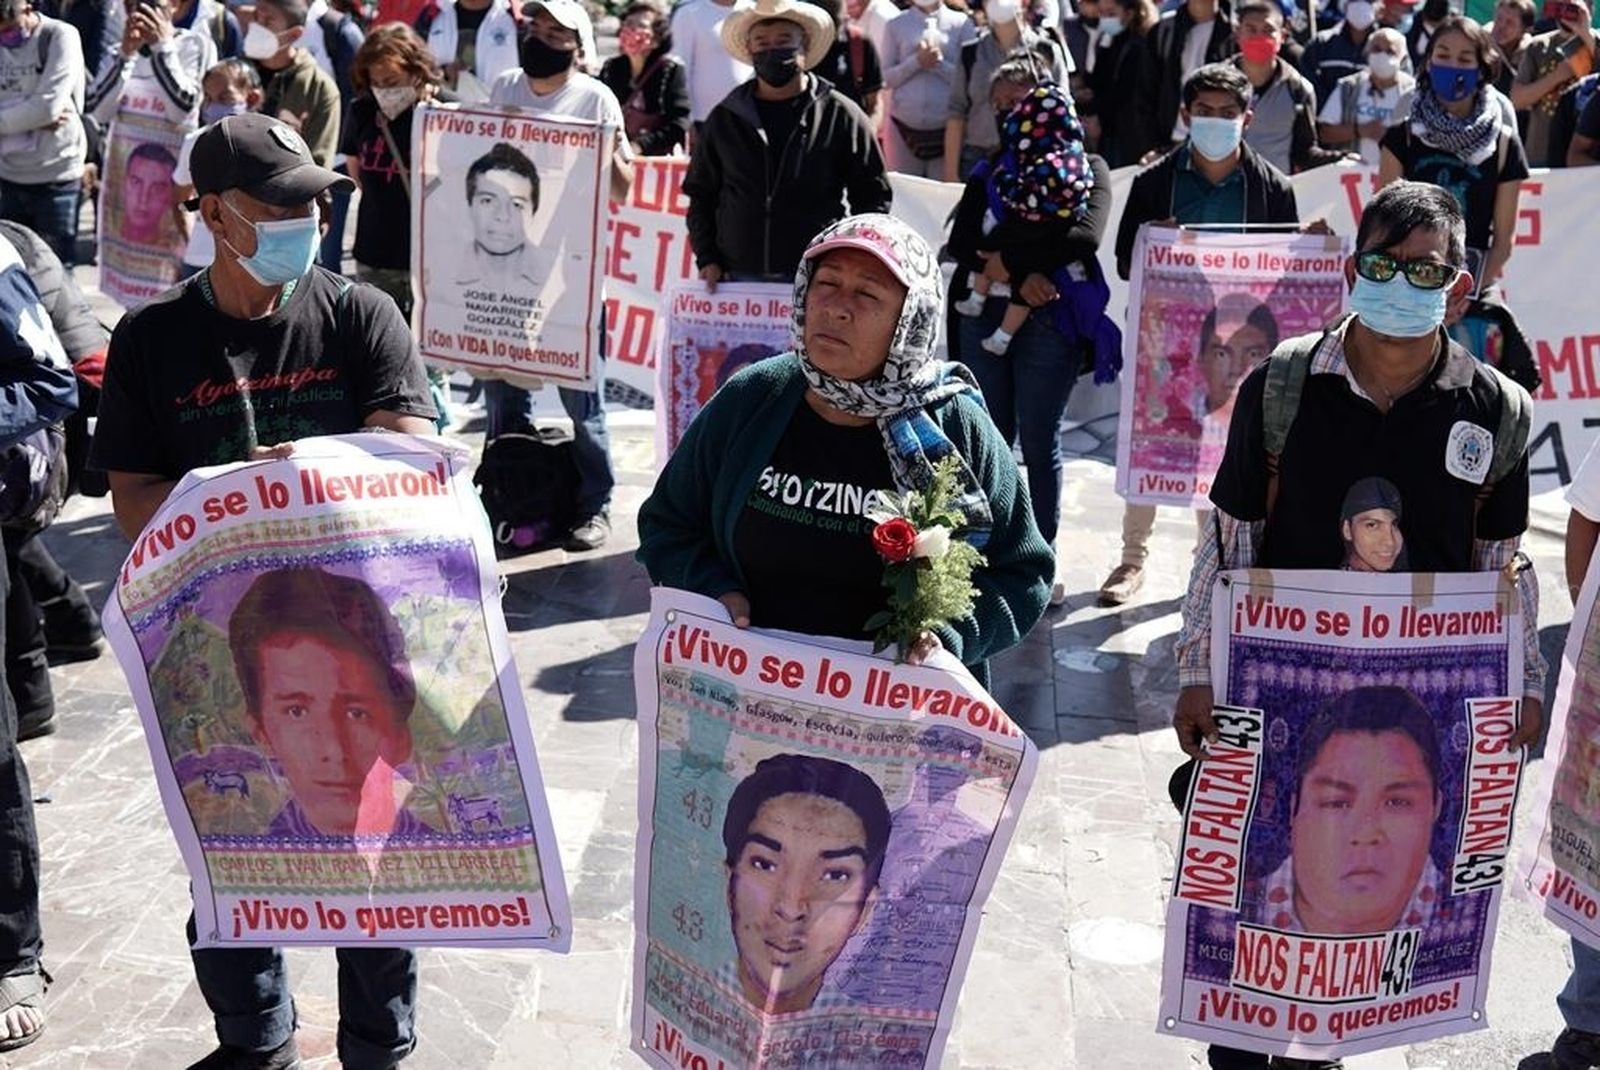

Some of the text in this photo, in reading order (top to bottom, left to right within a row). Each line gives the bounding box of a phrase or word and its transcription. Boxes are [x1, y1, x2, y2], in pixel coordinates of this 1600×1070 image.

[479, 120, 497, 137] se
[501, 119, 517, 139] lo
[521, 123, 596, 149] llevaron!
[1149, 246, 1342, 273] ¡Vivo se lo llevaron!
[674, 294, 712, 315] ¡Vivo
[718, 302, 739, 315] se
[745, 299, 762, 316] lo
[458, 335, 488, 355] VIDA
[493, 339, 506, 356] lo
[508, 345, 579, 369] queremos!
[202, 489, 249, 524] se
[255, 474, 290, 509] lo
[299, 462, 448, 506] llevaron!
[1139, 474, 1209, 494] ¡Vivo lo
[1235, 595, 1503, 639] ¡Vivo se lo llevaron!
[664, 624, 747, 676] ¡Vivo
[758, 655, 805, 688] se
[816, 658, 852, 699] lo
[746, 702, 798, 727] Glasgow,
[805, 718, 859, 740] Escocia,
[866, 733, 905, 746] quiero
[1473, 701, 1514, 754] NOS
[1189, 746, 1255, 844] FALTAN
[1463, 762, 1519, 854] FALTAN
[1552, 822, 1593, 857] MIGUEL
[219, 856, 275, 872] CARLOS
[415, 855, 524, 870] VILLARREAL
[1180, 847, 1238, 907] NOS
[233, 897, 530, 938] ¡Vivo lo queremos!
[1539, 869, 1598, 920] ¡Vivo
[1234, 930, 1420, 998] NOS FALTAN 43!
[1199, 982, 1460, 1040] ¡Vivo lo queremos!
[655, 1019, 708, 1070] ¡Vivo
